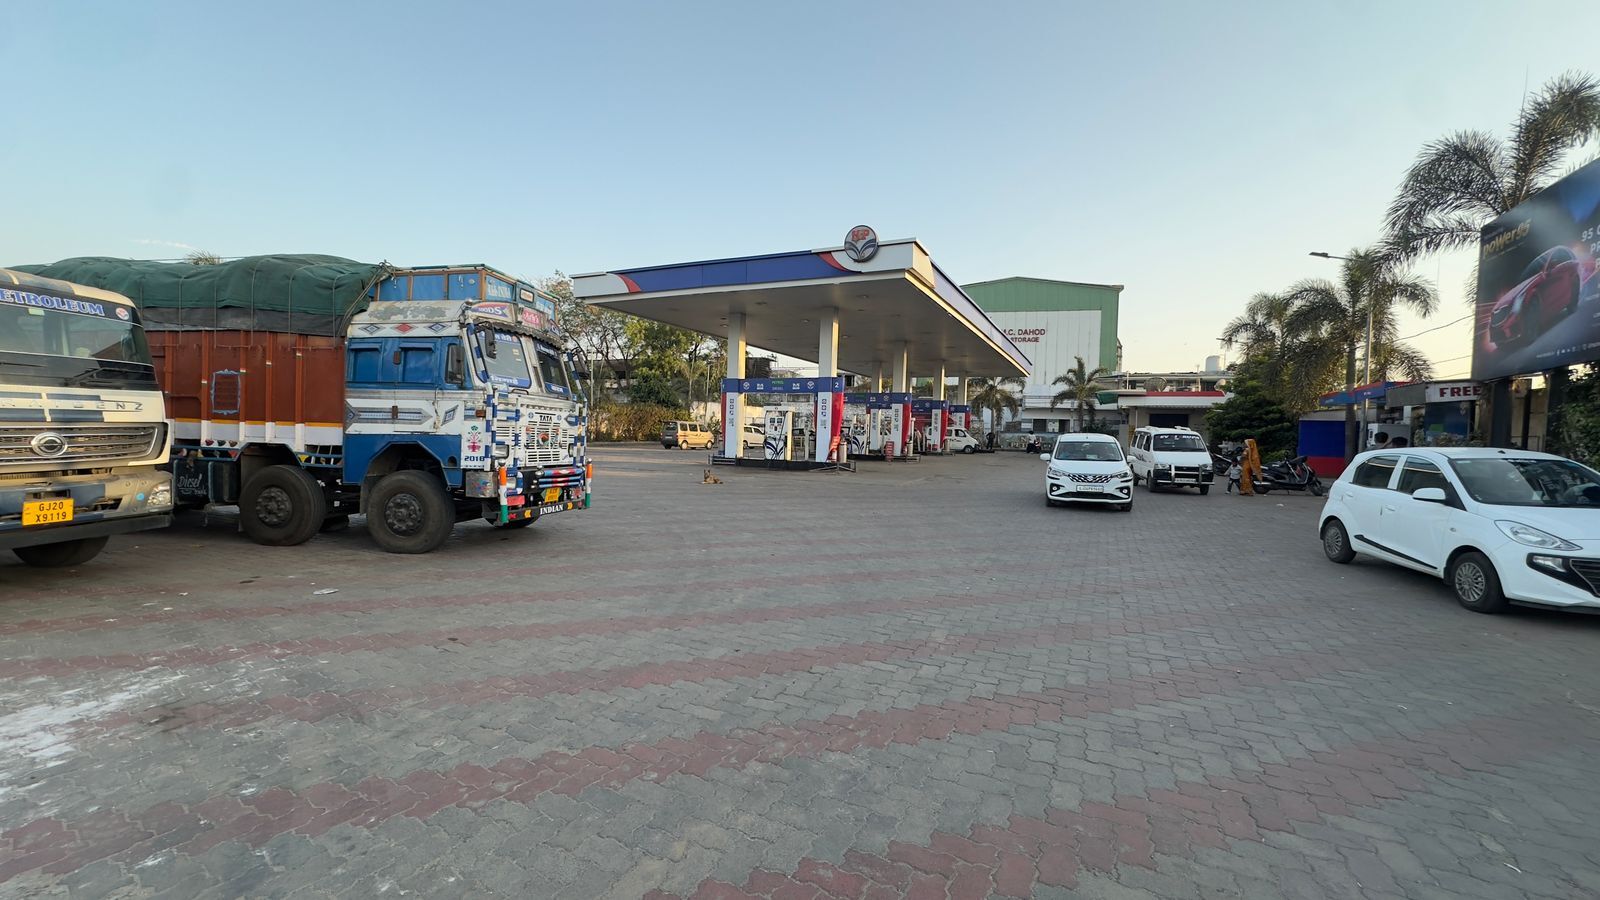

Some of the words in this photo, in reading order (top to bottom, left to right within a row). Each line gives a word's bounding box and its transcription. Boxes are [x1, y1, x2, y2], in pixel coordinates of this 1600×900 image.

[0, 289, 105, 316] ETROLEUM
[1017, 328, 1046, 336] DAHOD
[1439, 385, 1482, 398] FREE
[39, 501, 64, 512] GJ20
[540, 503, 564, 515] INDIAN
